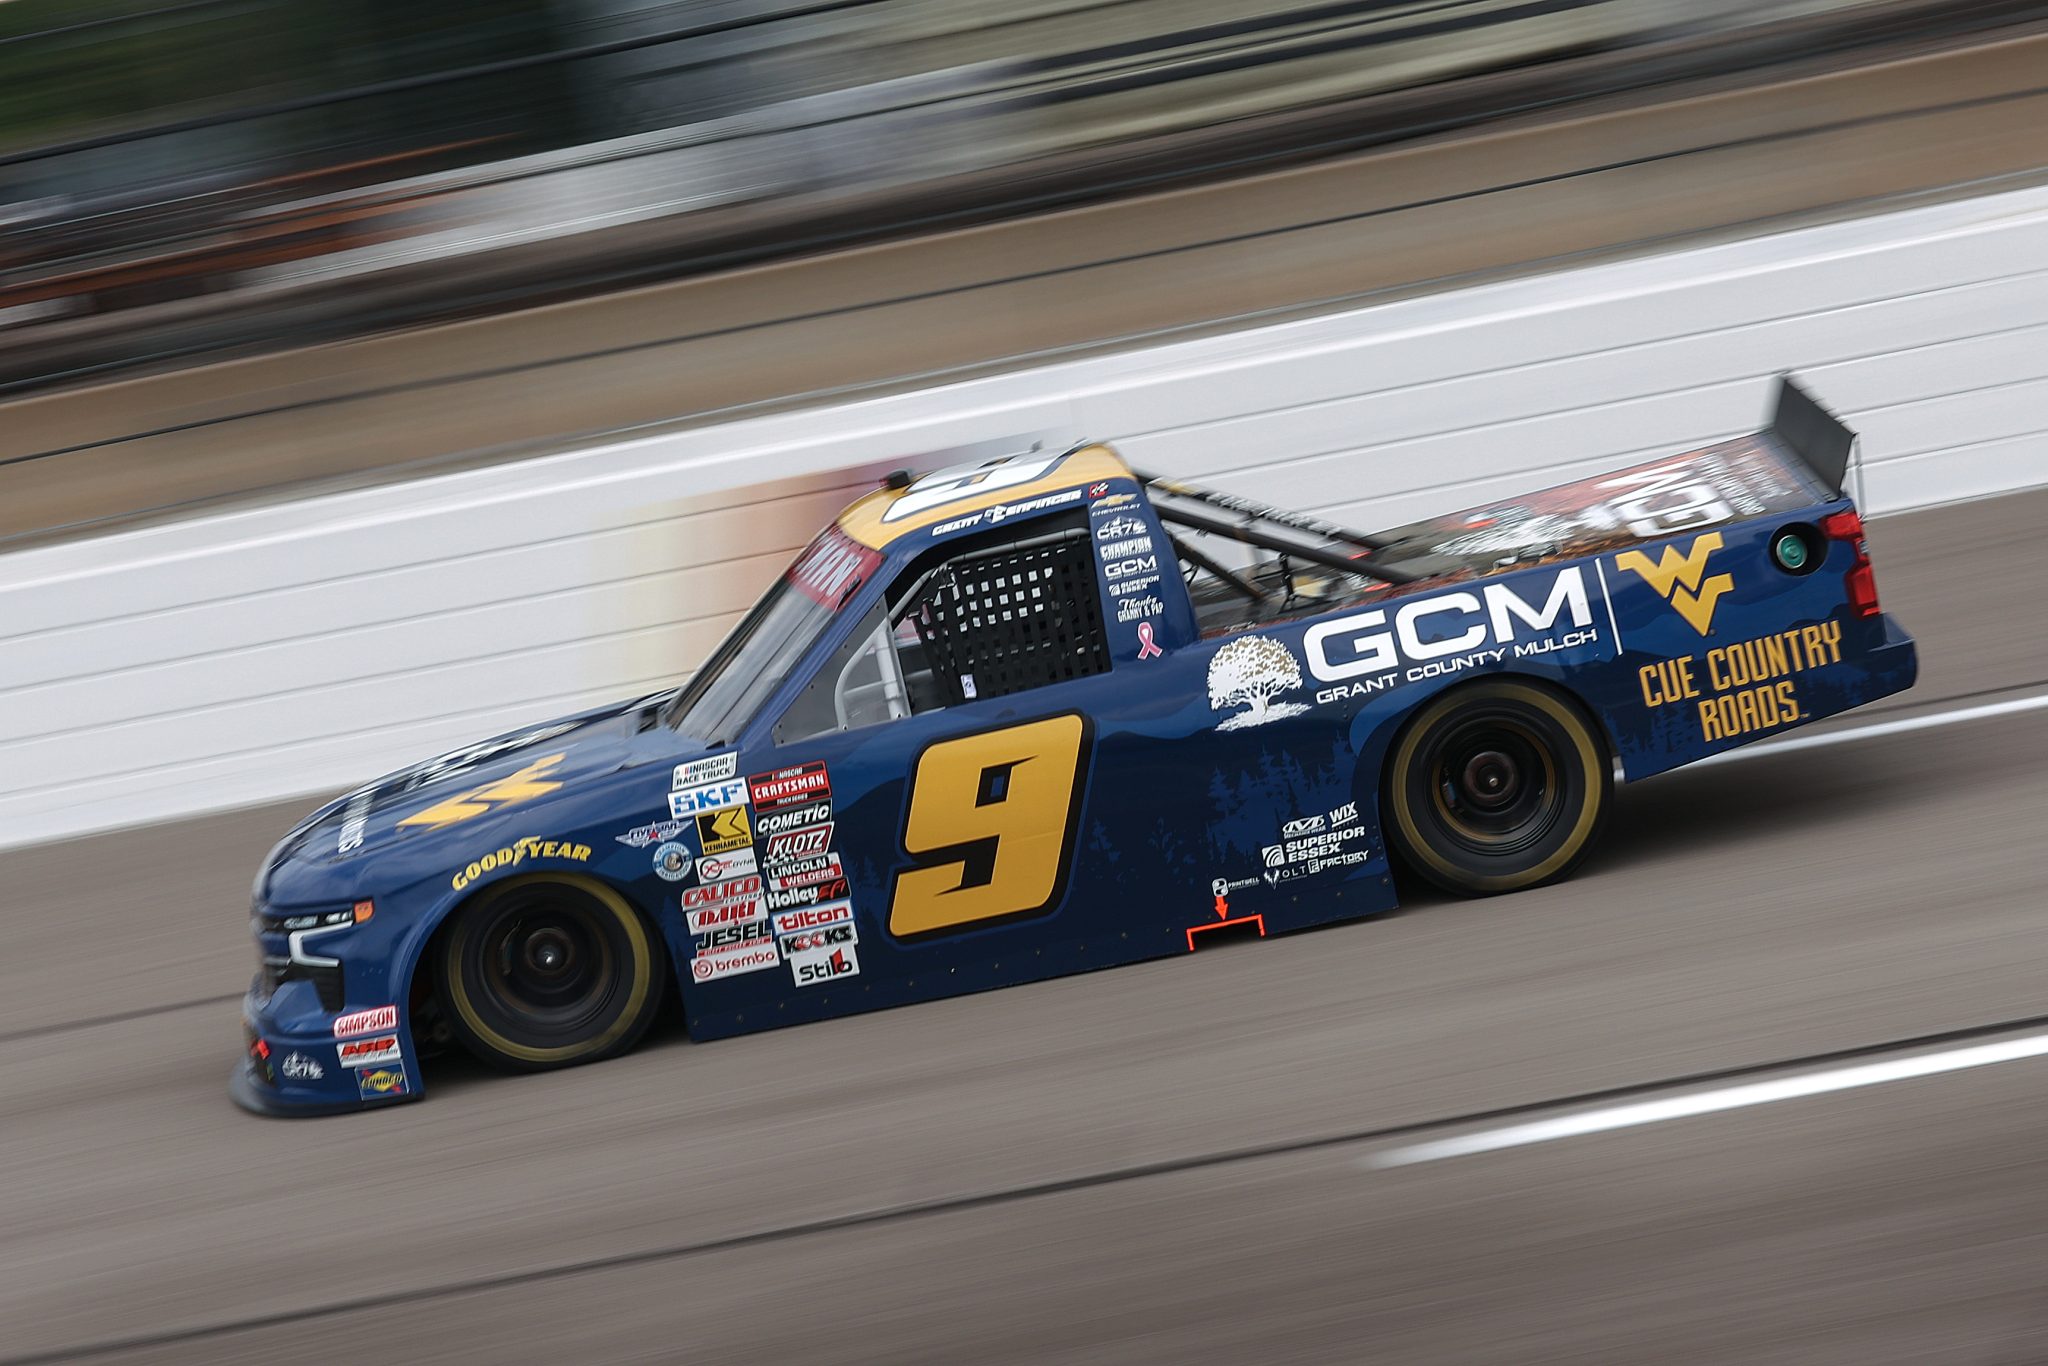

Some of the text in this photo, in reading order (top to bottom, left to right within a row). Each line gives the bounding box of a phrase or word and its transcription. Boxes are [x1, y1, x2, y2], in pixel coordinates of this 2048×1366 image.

[1092, 503, 1141, 517] CHEVROLET
[1100, 536, 1152, 558] CHAMPION
[1104, 555, 1157, 578] GCM
[1120, 575, 1160, 589] SUPERIOR
[1117, 607, 1142, 622] GRANNY
[1150, 602, 1164, 615] PAP
[1302, 565, 1593, 683] GCM
[1316, 627, 1598, 705] GRANT COUNTY MULCH
[1638, 620, 1843, 708] CUE COUNTRY
[1697, 680, 1801, 743] ROADS
[676, 766, 730, 786] RACE TRUCK
[692, 757, 729, 772] NASCAR
[778, 766, 803, 780] NASCAR
[674, 782, 743, 814] SKF
[754, 773, 825, 800] CRAFTSMAN
[757, 802, 830, 833] COMETIC
[1329, 801, 1358, 823] WIX
[889, 714, 1084, 937] 9
[704, 836, 750, 852] KENNAMETAL
[772, 828, 827, 859] KLOTZ
[1286, 826, 1365, 852] SUPERIOR
[1288, 842, 1341, 863] ESSEX
[770, 857, 828, 878] LINCOLN
[785, 868, 835, 886] WELDERS
[683, 876, 760, 908] CALICO
[767, 886, 818, 910] Holley
[778, 906, 849, 931] tilton
[696, 920, 772, 949] JESEL
[783, 925, 852, 953] KOOKS
[715, 950, 775, 972] brembo
[337, 1007, 394, 1034] SIMPSON
